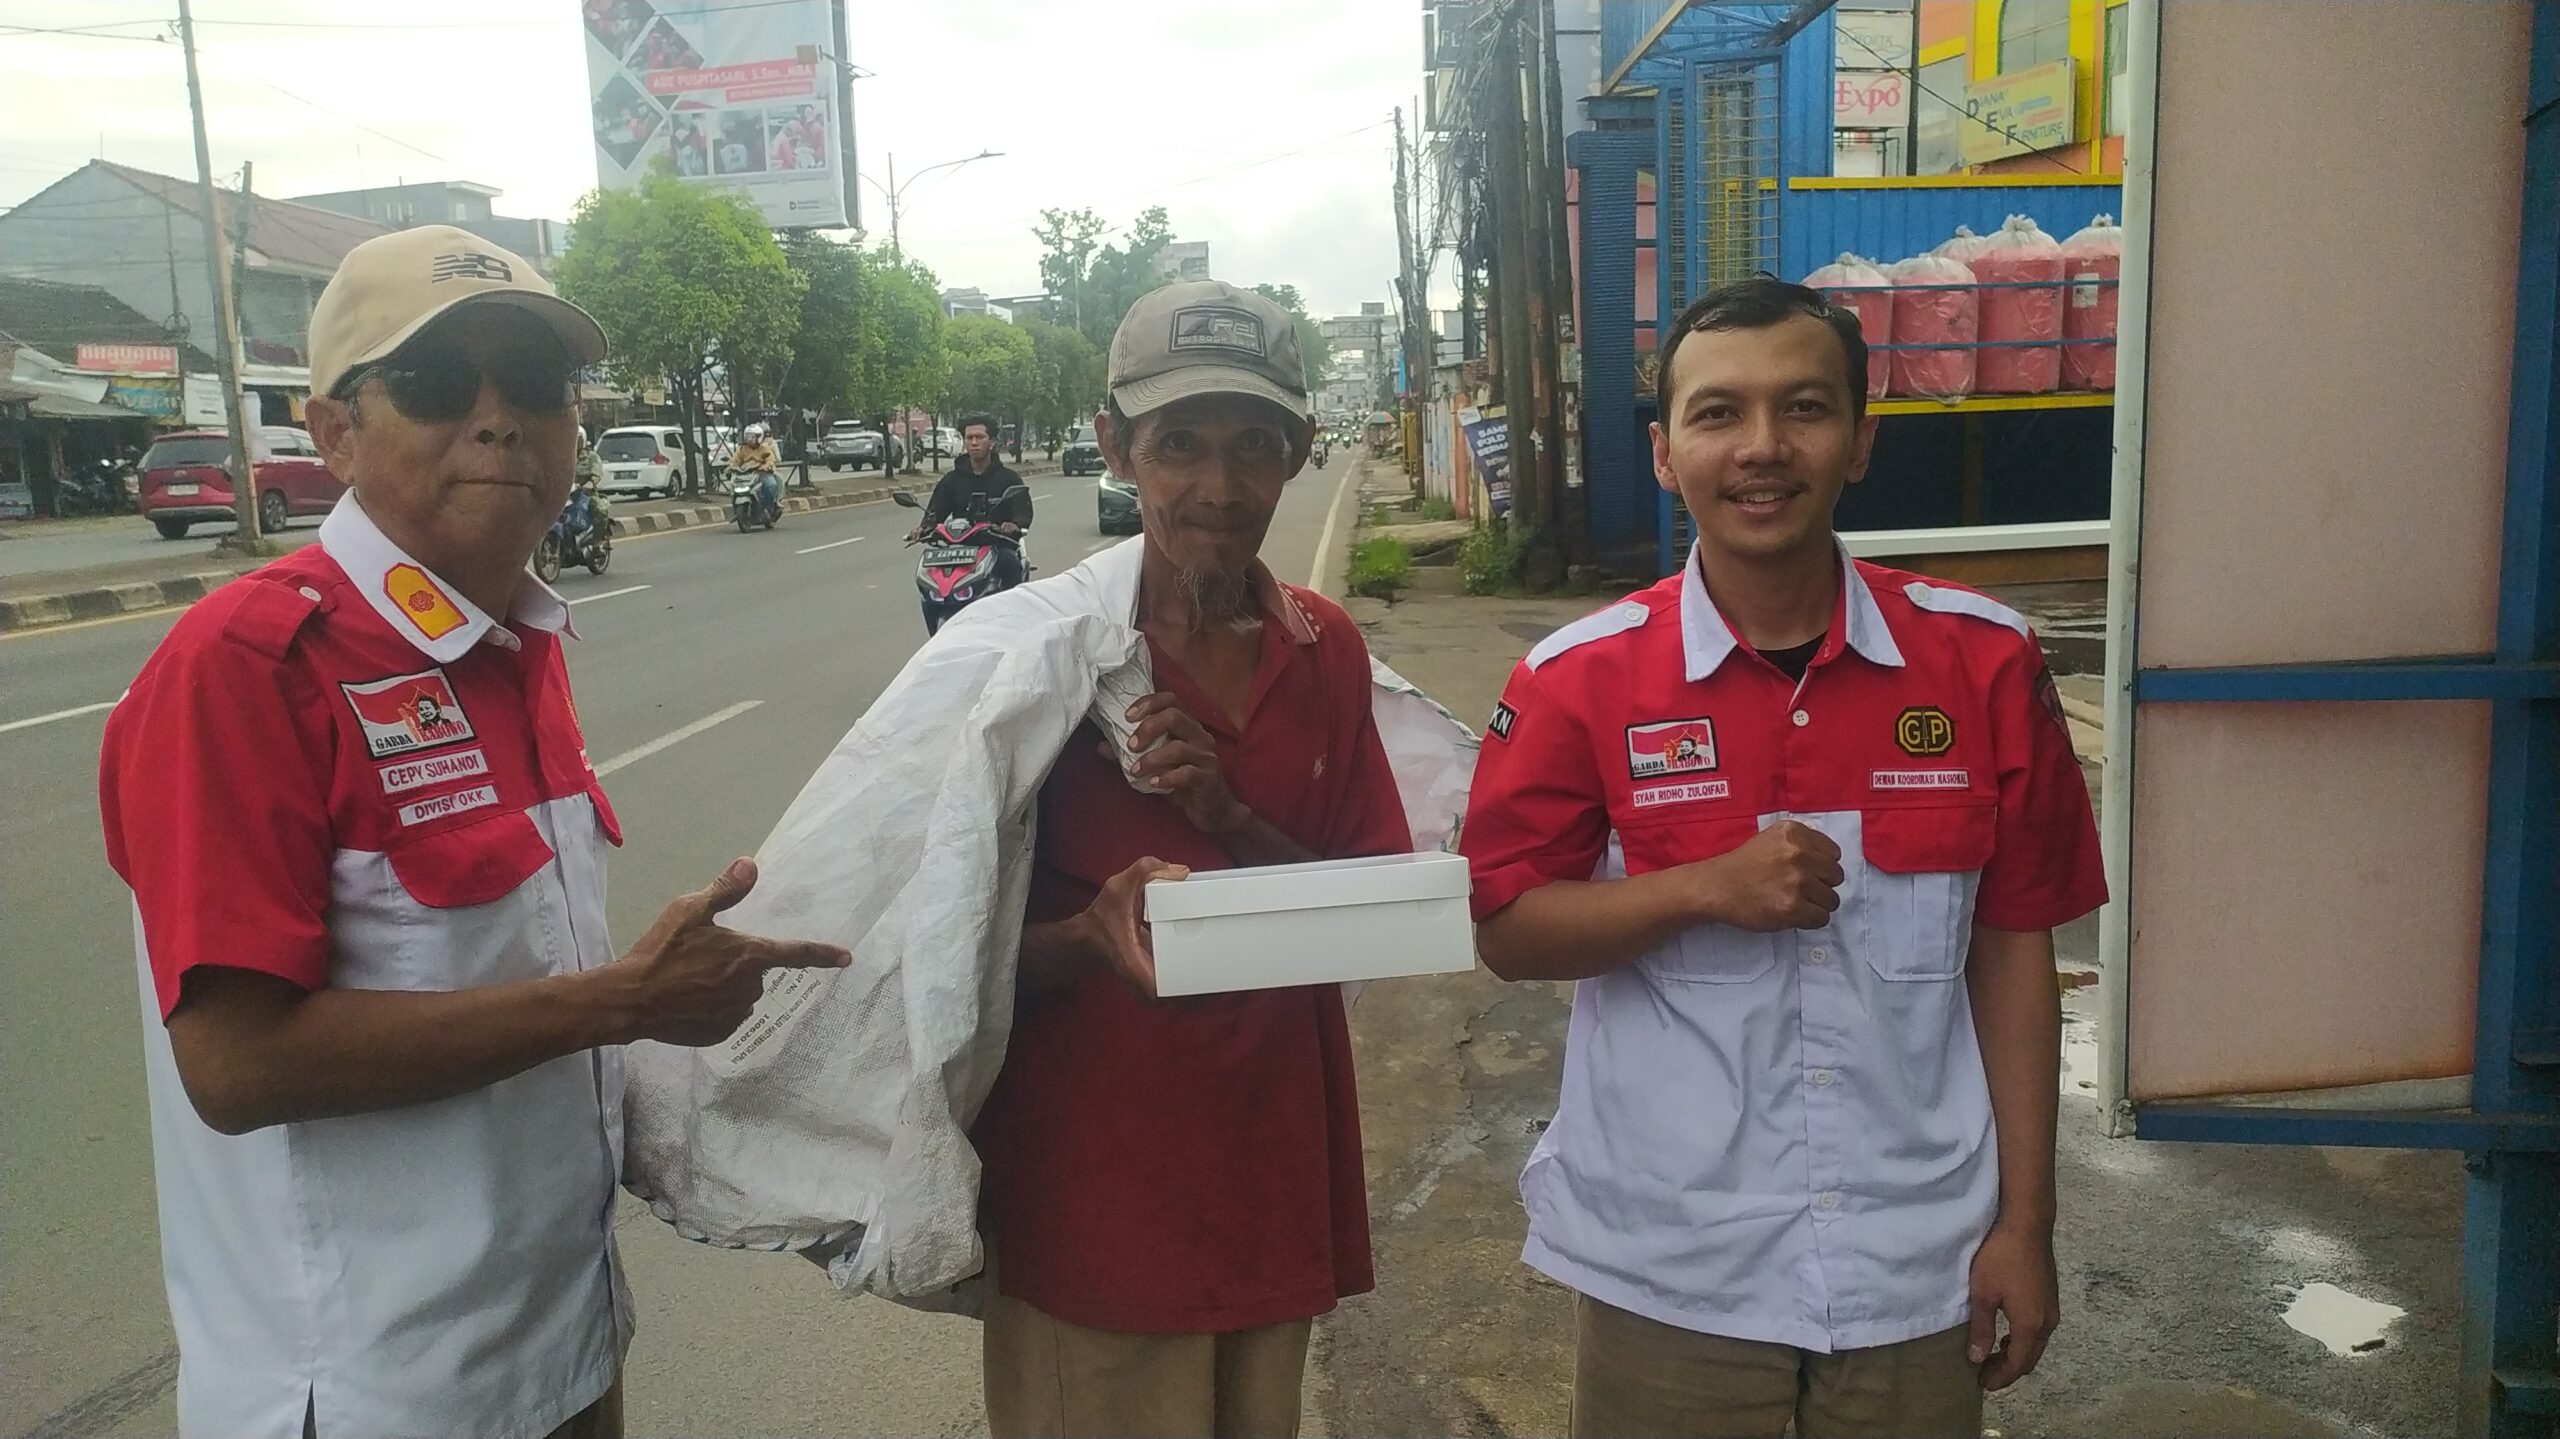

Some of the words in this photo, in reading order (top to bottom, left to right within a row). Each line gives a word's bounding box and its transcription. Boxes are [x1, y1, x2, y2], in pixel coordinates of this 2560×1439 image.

[1836, 75, 1901, 115] Expo
[1489, 705, 1512, 735] KN
[374, 733, 414, 751] GARDA
[387, 764, 425, 788] CEPY
[425, 754, 481, 778] SUHANDI
[1633, 760, 1665, 772] GARDA
[1635, 790, 1655, 804] SYAH
[1658, 788, 1684, 801] RIDHO
[1687, 783, 1727, 798] ZULQIFAR
[414, 796, 456, 820] DIVISI
[459, 789, 486, 806] OKK
[797, 968, 810, 984] Lot
[784, 983, 799, 996] No.
[801, 978, 821, 1000] Product
